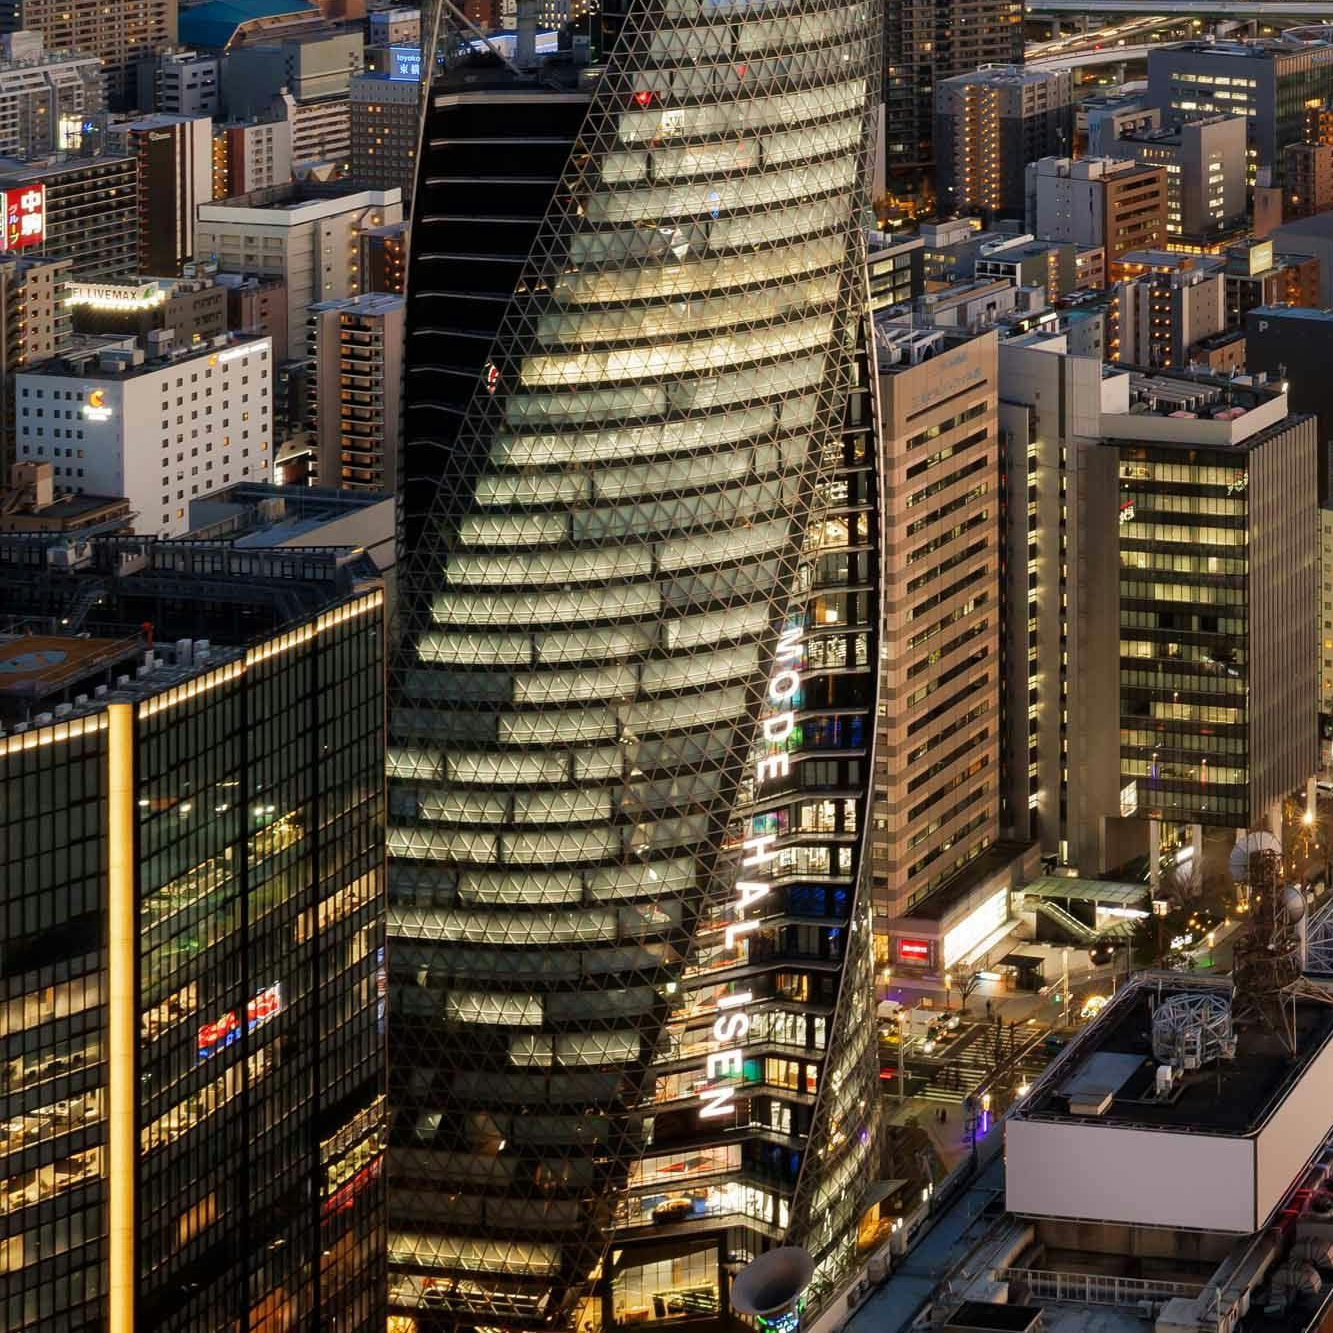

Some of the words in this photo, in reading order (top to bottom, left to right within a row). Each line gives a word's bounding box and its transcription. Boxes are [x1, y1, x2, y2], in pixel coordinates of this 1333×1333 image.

[87, 289, 137, 301] LIVEMAX
[756, 626, 804, 784] MODE
[724, 833, 777, 950] HAL
[698, 991, 753, 1119] ISEN
